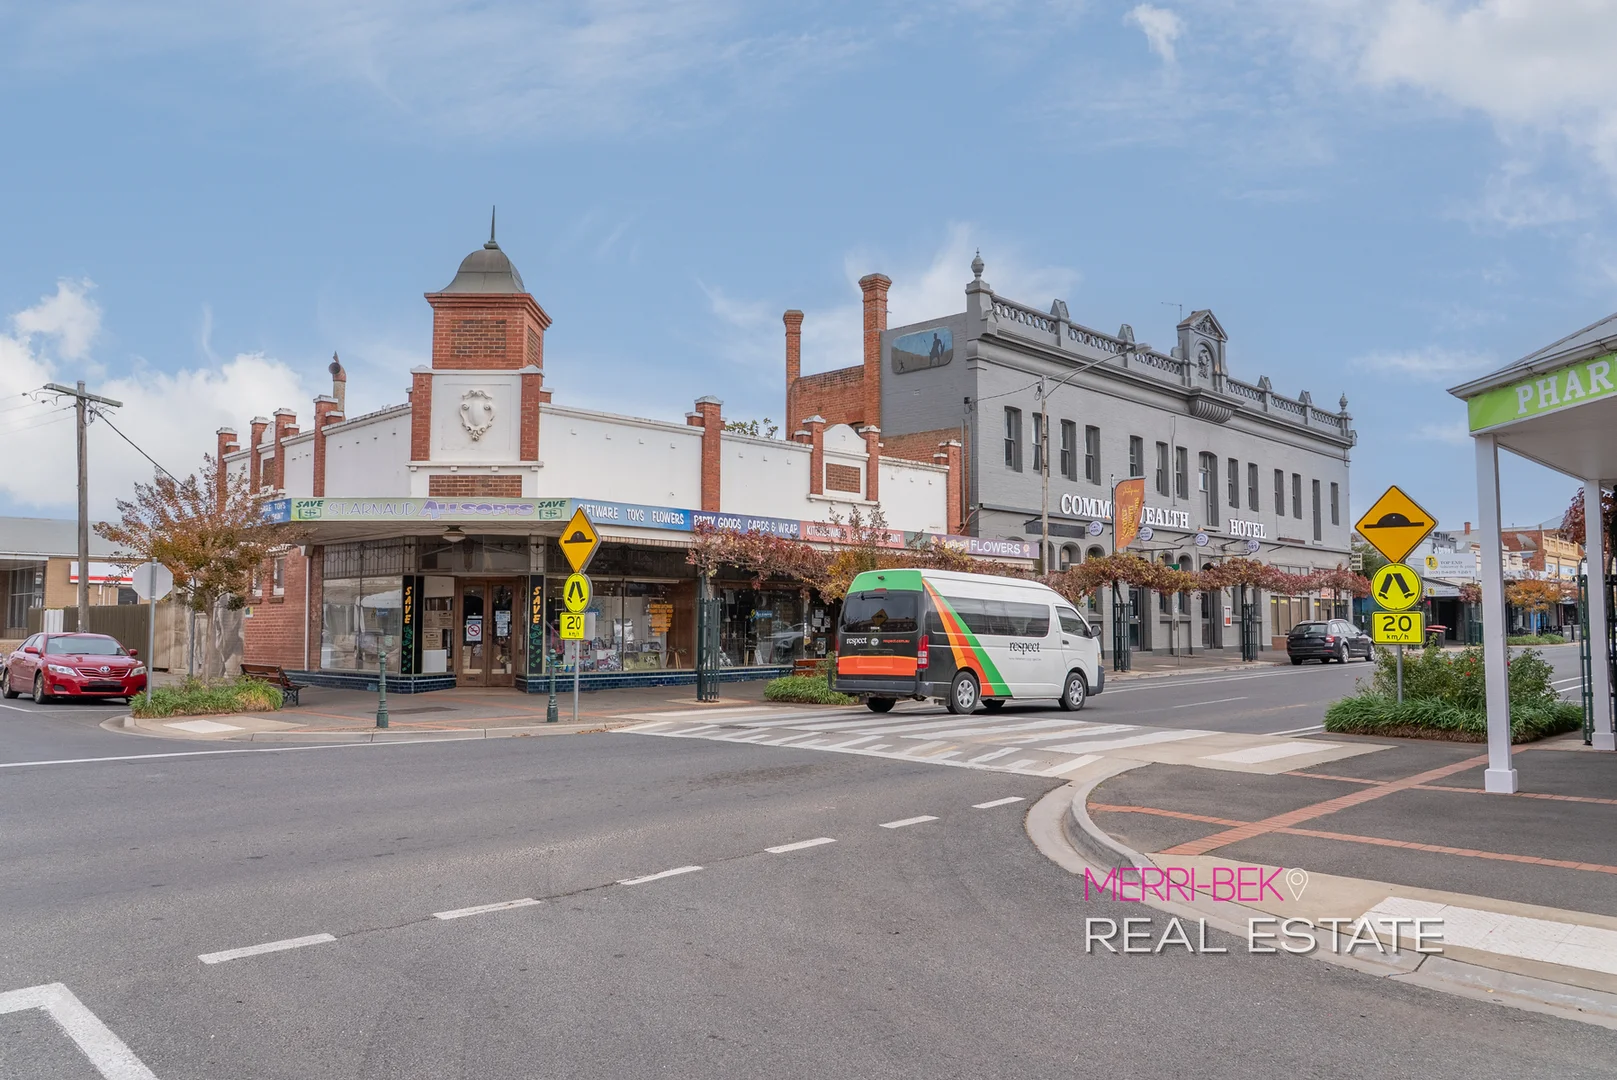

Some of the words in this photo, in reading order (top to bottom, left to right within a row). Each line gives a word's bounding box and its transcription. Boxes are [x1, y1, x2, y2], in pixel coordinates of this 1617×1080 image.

[1516, 357, 1617, 414] PHAR
[274, 501, 286, 510] TOYS
[296, 500, 324, 508] SAVE
[538, 500, 566, 508] SAVE
[626, 509, 645, 522] TOYS
[652, 511, 685, 525] FLOWERS
[1061, 494, 1190, 529] COMMEALTH
[1229, 519, 1266, 539] HOTEL
[717, 517, 742, 530] GOODS
[747, 519, 770, 532] CARDS
[770, 523, 777, 532] &
[777, 522, 798, 534] WRAP
[806, 525, 847, 541] KITCWA
[970, 540, 1021, 554] FLOWERS
[404, 586, 413, 624] SAVE
[532, 586, 542, 624] SAVE
[566, 616, 582, 630] 20
[1382, 615, 1412, 632] 20
[846, 637, 867, 645] respect
[1009, 642, 1040, 655] respect
